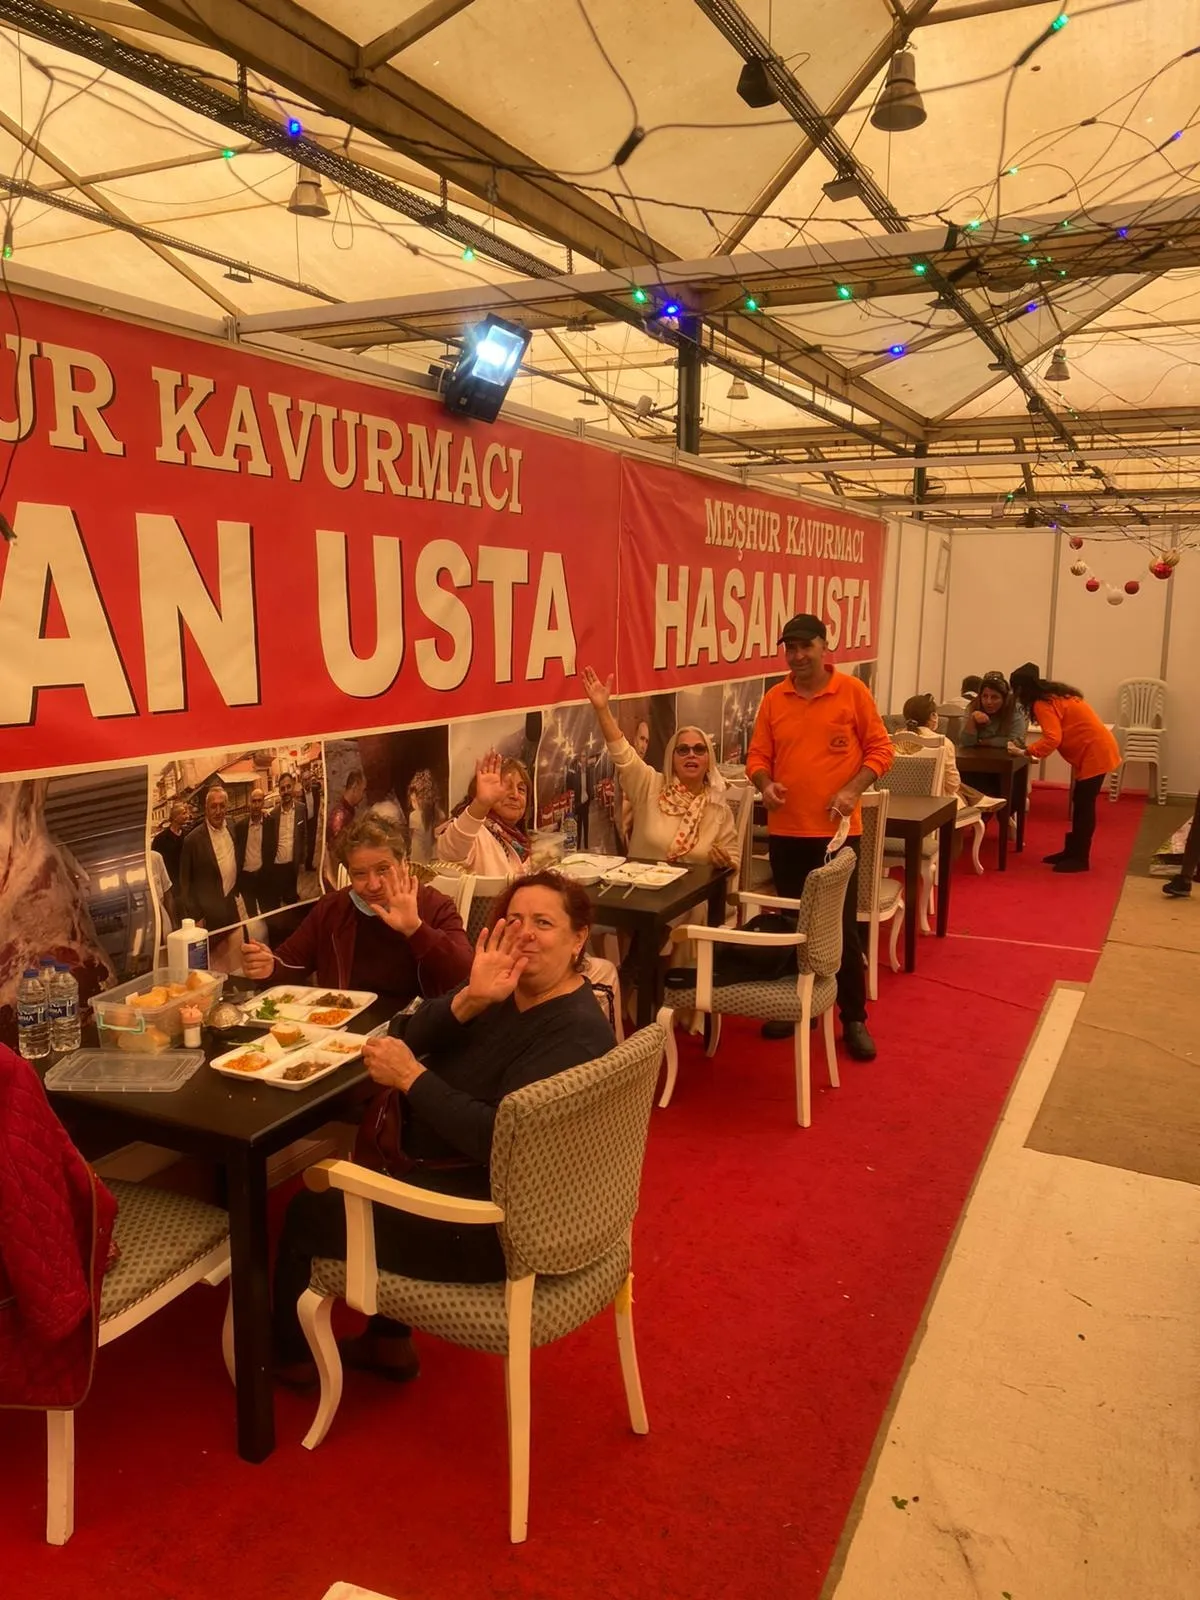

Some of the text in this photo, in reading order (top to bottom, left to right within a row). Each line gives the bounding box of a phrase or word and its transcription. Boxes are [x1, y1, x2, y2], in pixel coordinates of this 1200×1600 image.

[151, 366, 523, 513] KAVURMACI
[704, 498, 864, 563] MEŞHUR KAVURMACI
[315, 529, 577, 698] USTA
[653, 563, 796, 669] HASAN
